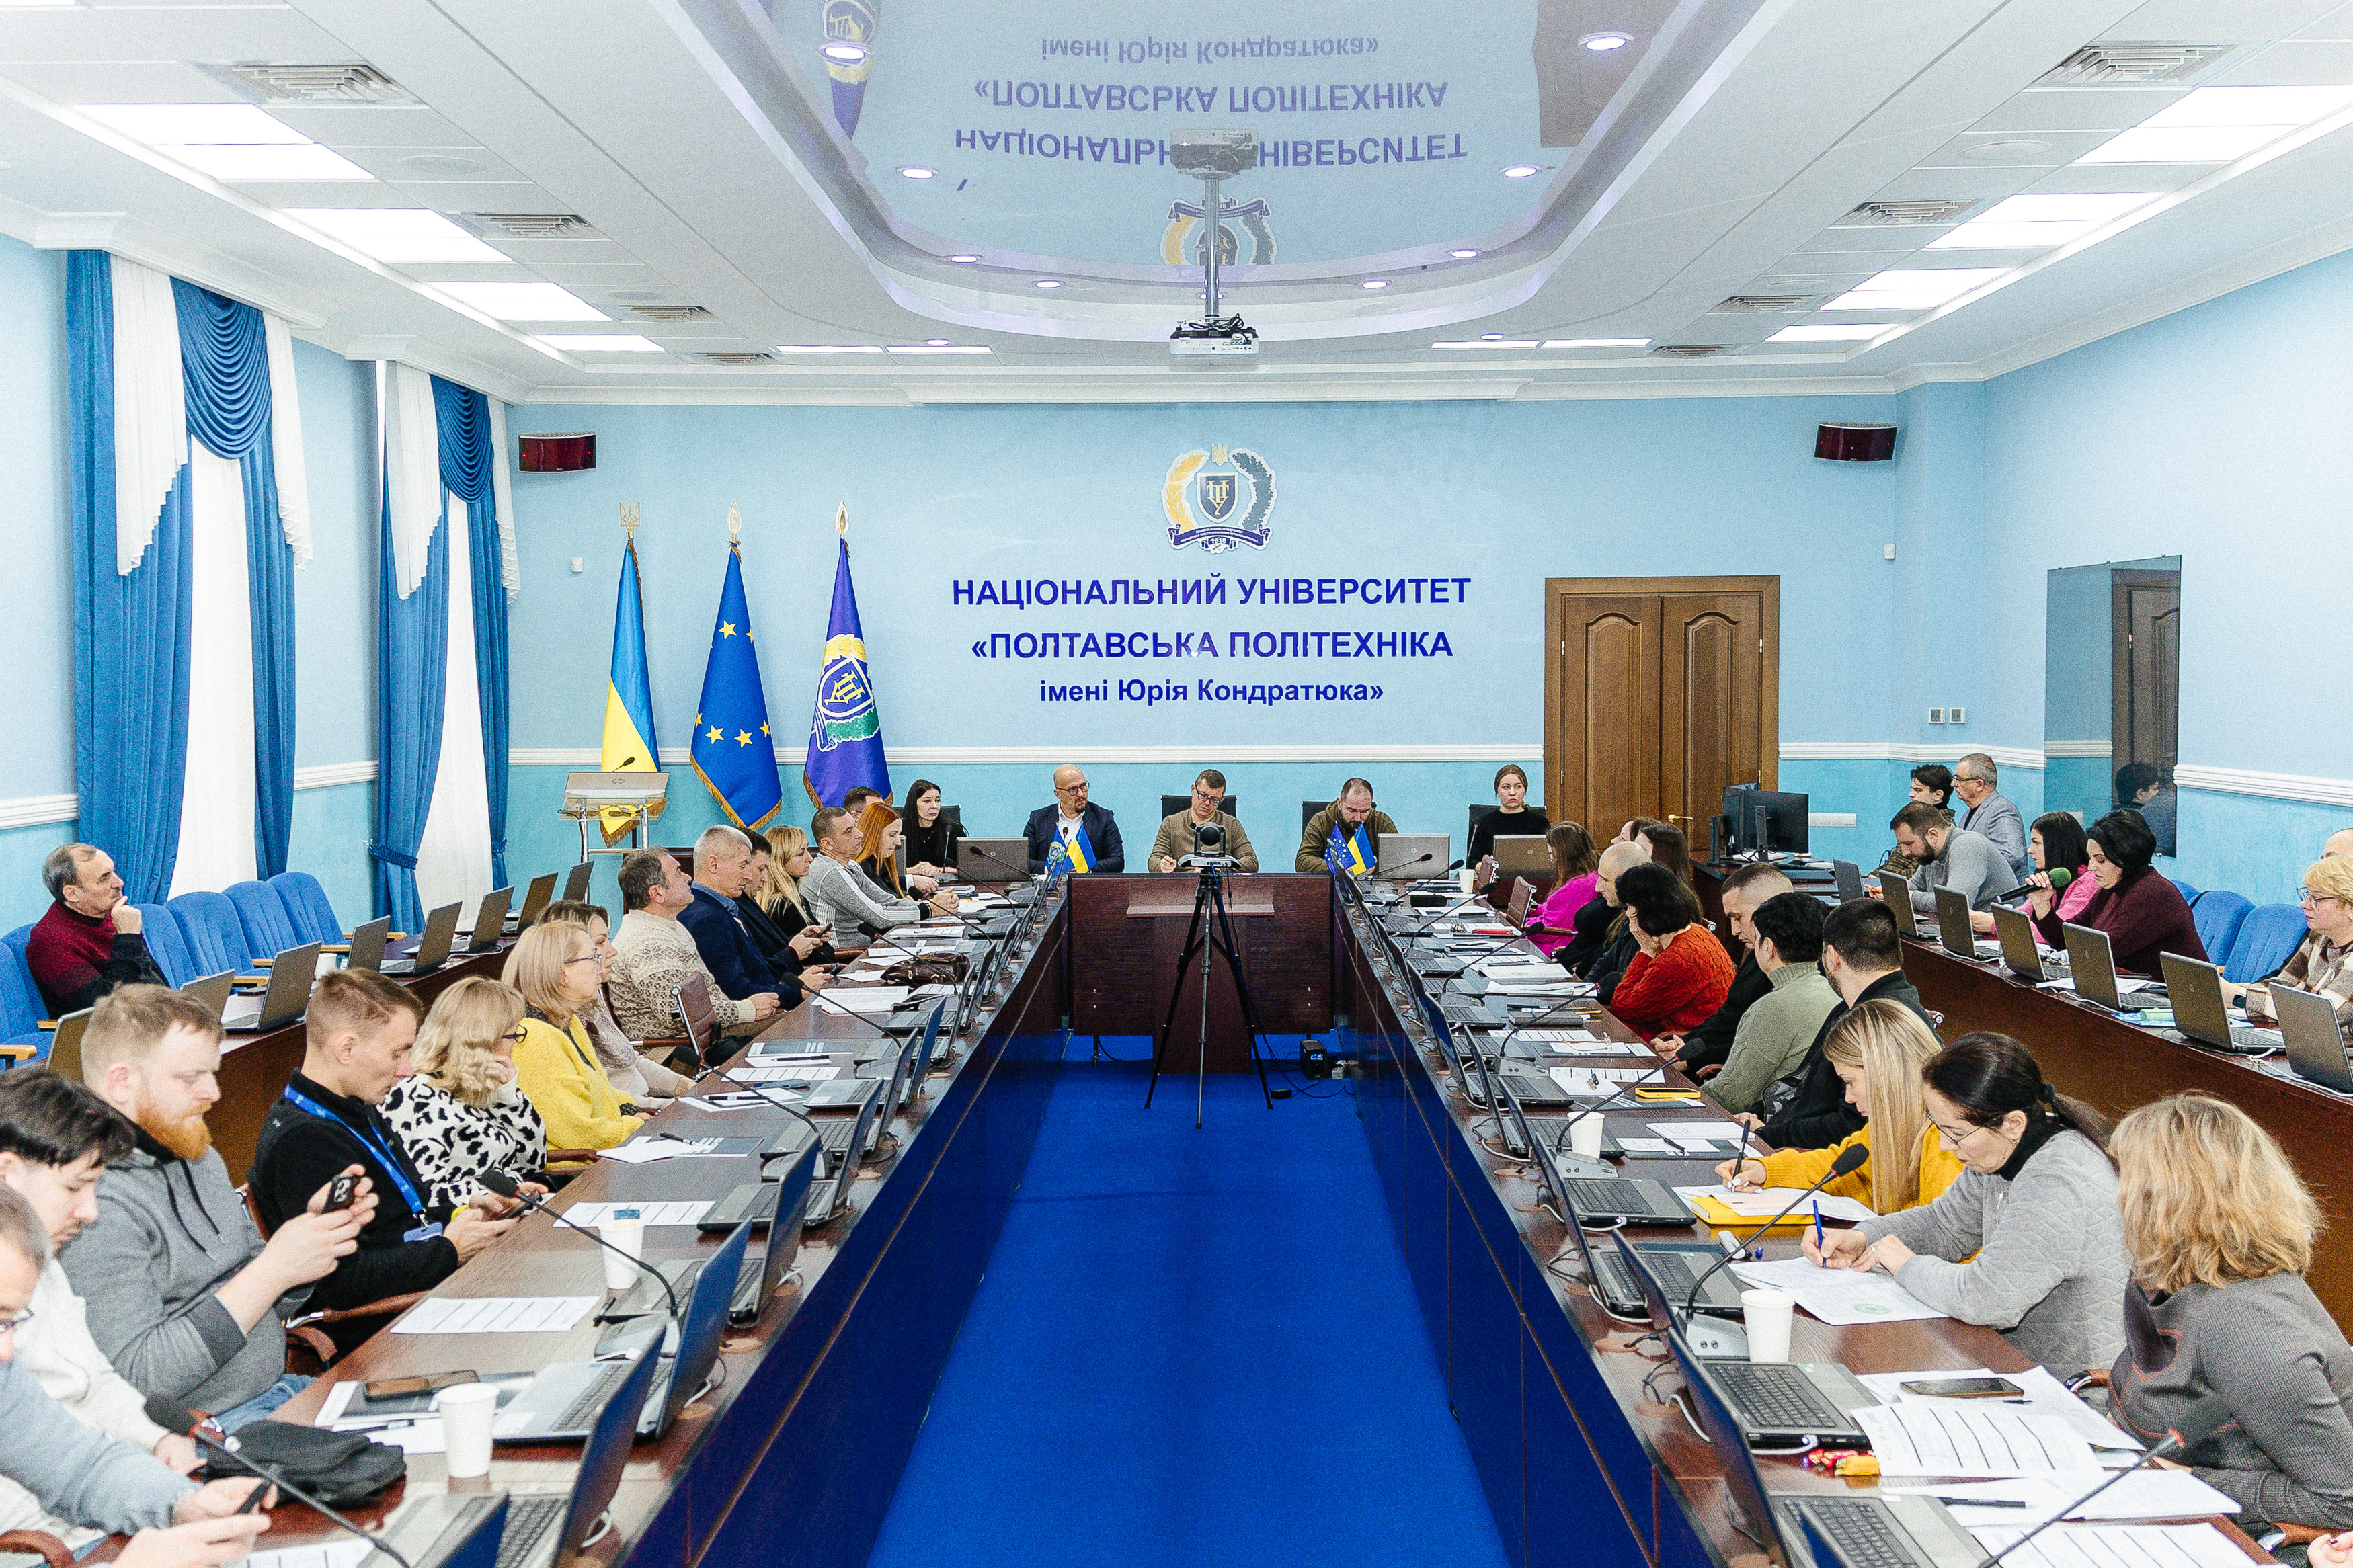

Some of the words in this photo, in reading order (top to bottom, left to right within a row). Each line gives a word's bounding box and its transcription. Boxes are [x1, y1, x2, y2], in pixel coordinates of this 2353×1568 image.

[953, 573, 1226, 610] НАЦІОНАЛЬНИЙ
[1237, 577, 1472, 605] УНІВЕРСИТЕТ
[971, 632, 1218, 658] «ПОЛТАВСЬКА
[1230, 631, 1453, 657] ПОЛІТЕХНІКА
[1041, 679, 1108, 702] імені
[1118, 679, 1187, 706] Юрія
[1198, 679, 1384, 706] Кондратюка»
